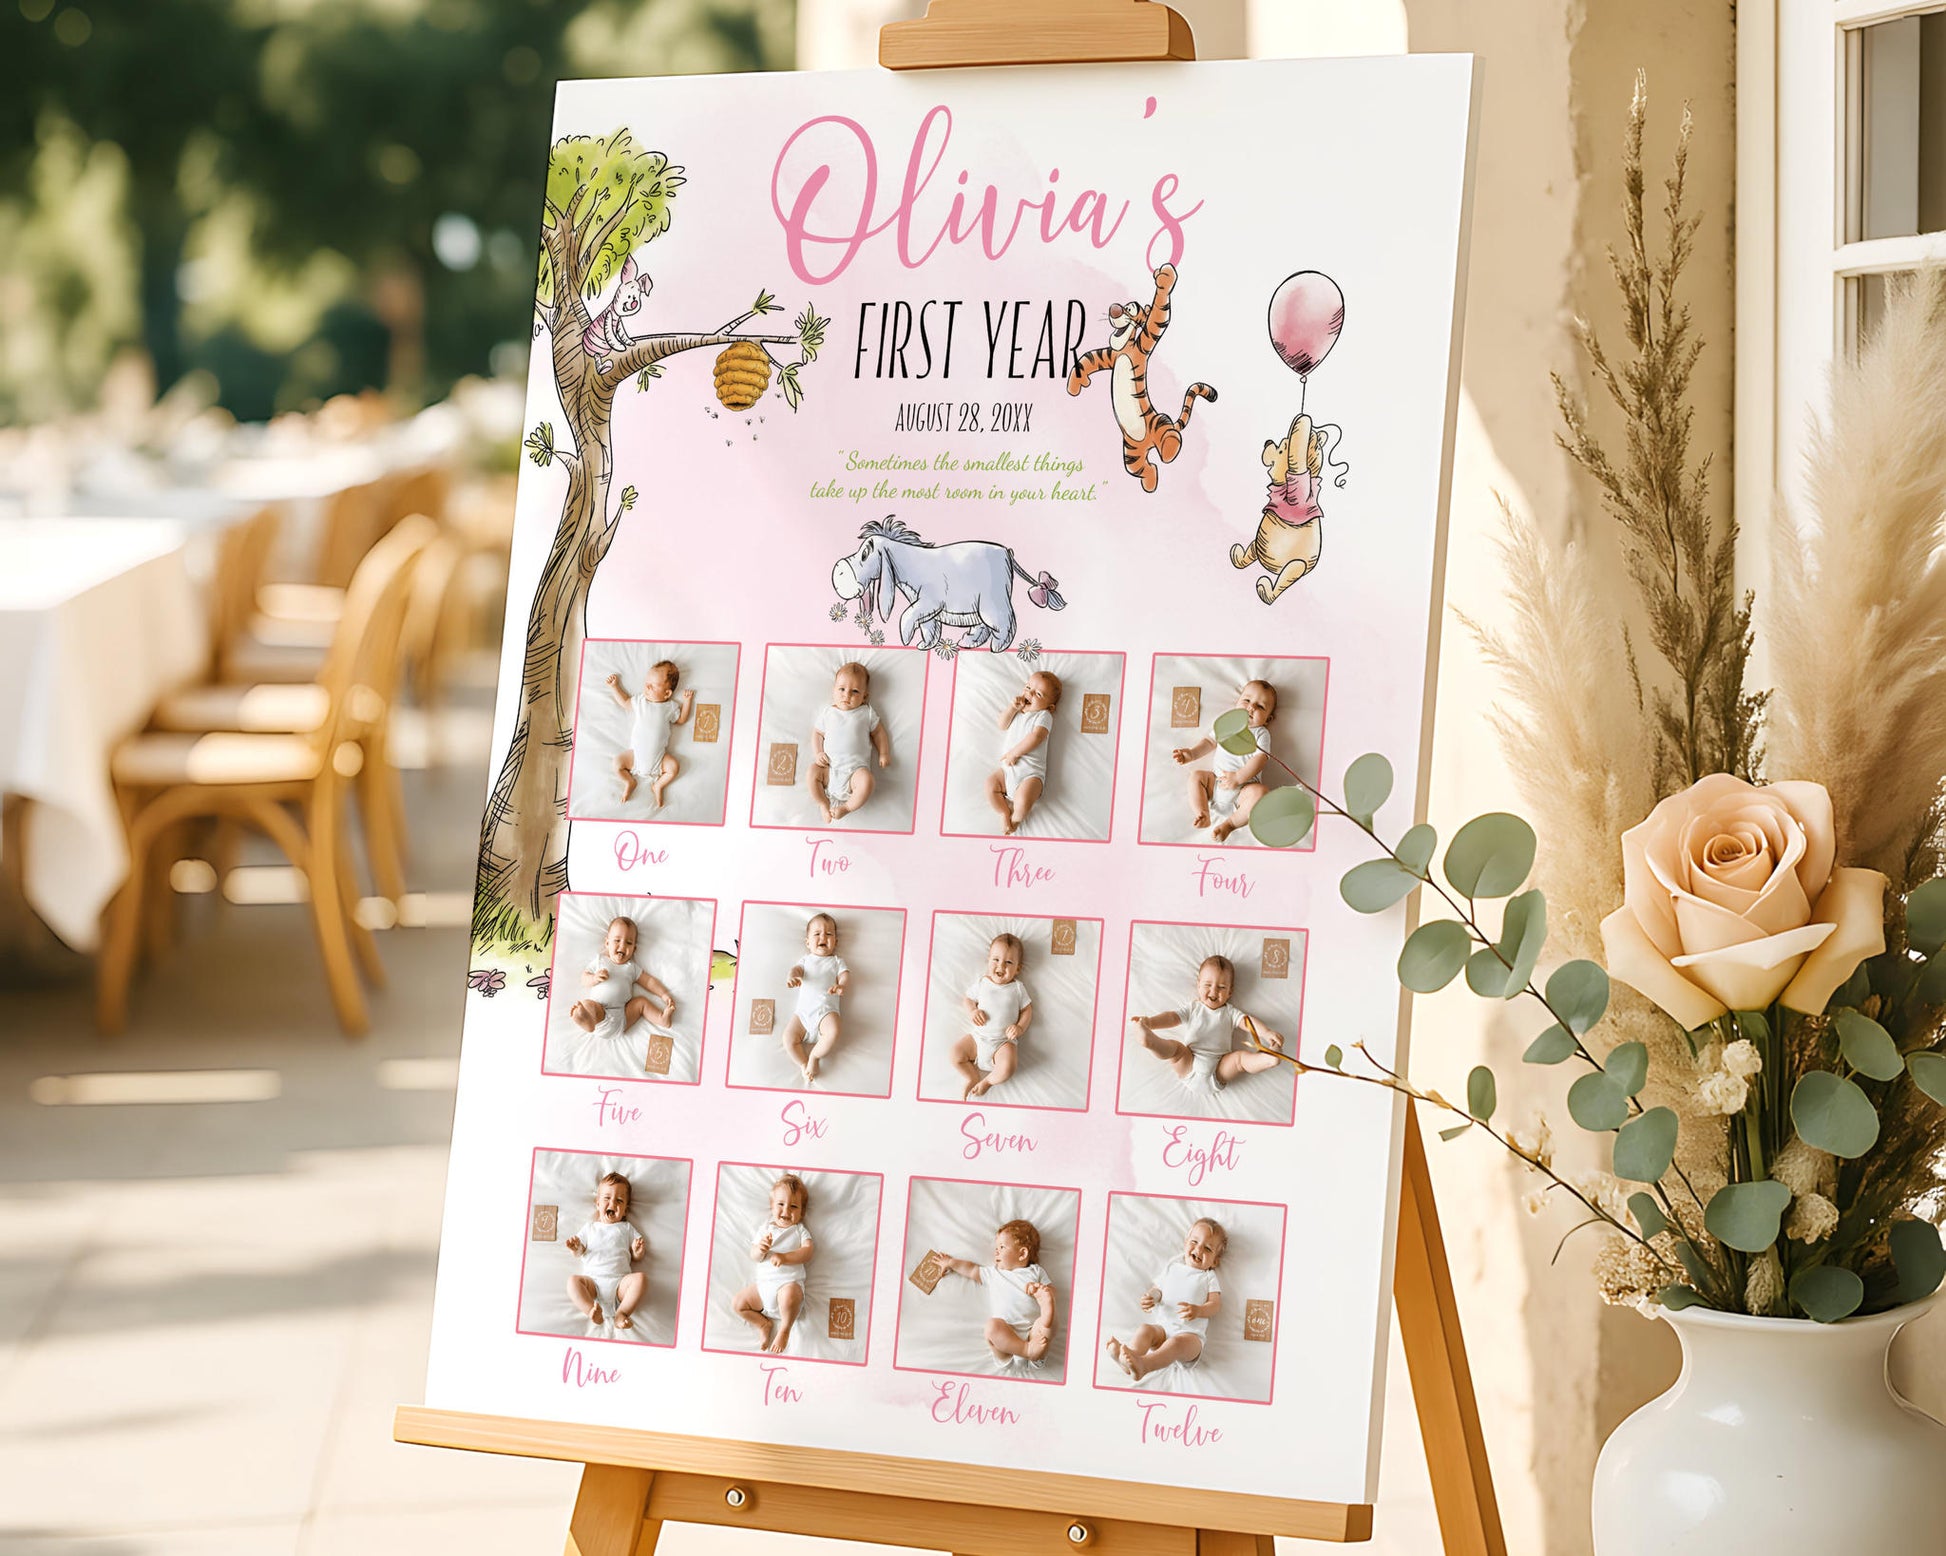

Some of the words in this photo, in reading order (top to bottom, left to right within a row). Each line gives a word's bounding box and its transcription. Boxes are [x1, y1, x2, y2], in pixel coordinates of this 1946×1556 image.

[771, 96, 1204, 286] Olivia's
[855, 300, 962, 378] FIRST
[983, 299, 1085, 379] YEAR
[896, 403, 952, 431] AUGUST
[958, 402, 985, 434] 28,
[991, 403, 1032, 431] 20XX
[838, 449, 928, 472] "Sometimes
[933, 451, 959, 471] the
[962, 451, 1029, 473] smallest
[1033, 451, 1084, 478] things
[809, 479, 845, 499] take
[849, 487, 868, 503] up
[871, 479, 897, 499] the
[901, 483, 940, 500] most
[946, 488, 983, 500] room
[987, 484, 1004, 500] in
[1009, 488, 1045, 506] your
[1050, 479, 1109, 502] heart."
[613, 830, 670, 872] One
[805, 836, 853, 878] Two
[989, 843, 1056, 889] Three
[1191, 853, 1256, 899] Four
[592, 1085, 644, 1127] Five
[780, 1099, 829, 1147] Six
[960, 1111, 1039, 1160] Seven
[1162, 1124, 1247, 1187] Eight
[836, 1311, 848, 1324] 10
[562, 1346, 622, 1388] Nine
[759, 1362, 803, 1406] Ten
[930, 1380, 1022, 1425] Eleven
[1136, 1398, 1224, 1448] Twelve
